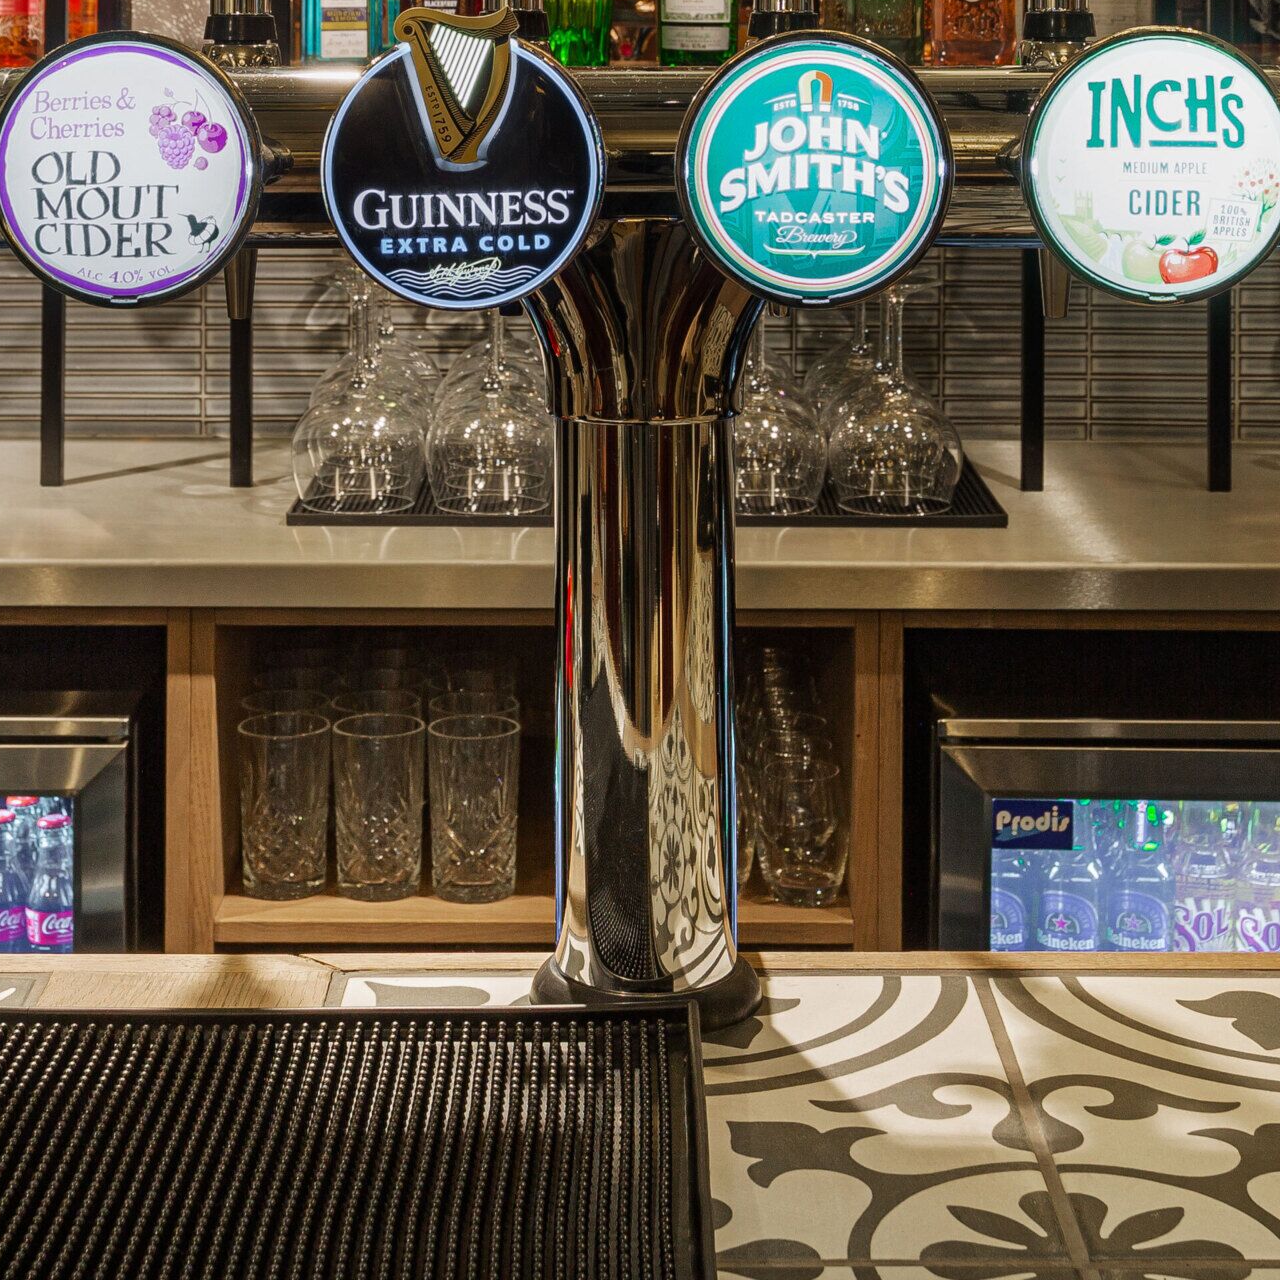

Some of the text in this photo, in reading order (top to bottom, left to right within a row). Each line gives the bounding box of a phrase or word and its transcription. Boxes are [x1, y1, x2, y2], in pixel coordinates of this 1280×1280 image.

[33, 87, 136, 114] Berries &
[30, 118, 124, 140] Cherries
[433, 112, 452, 143] 1759
[743, 115, 880, 162] JOHN
[31, 150, 121, 186] OLD
[1122, 161, 1209, 175] MEDIUM APPLE
[720, 153, 910, 214] SMITH'S
[32, 184, 179, 220] MOUT
[352, 188, 570, 230] GUINNESS
[1129, 189, 1201, 216] CIDER
[754, 210, 876, 224] TADCASTER
[1212, 214, 1251, 227] BRITISH
[34, 222, 177, 258] CIDER
[380, 234, 552, 255] EXTRA COLD
[775, 225, 858, 249] Brewery
[1213, 226, 1248, 238] APPLES
[109, 268, 144, 284] 4.0%
[996, 805, 1070, 836] Prodis
